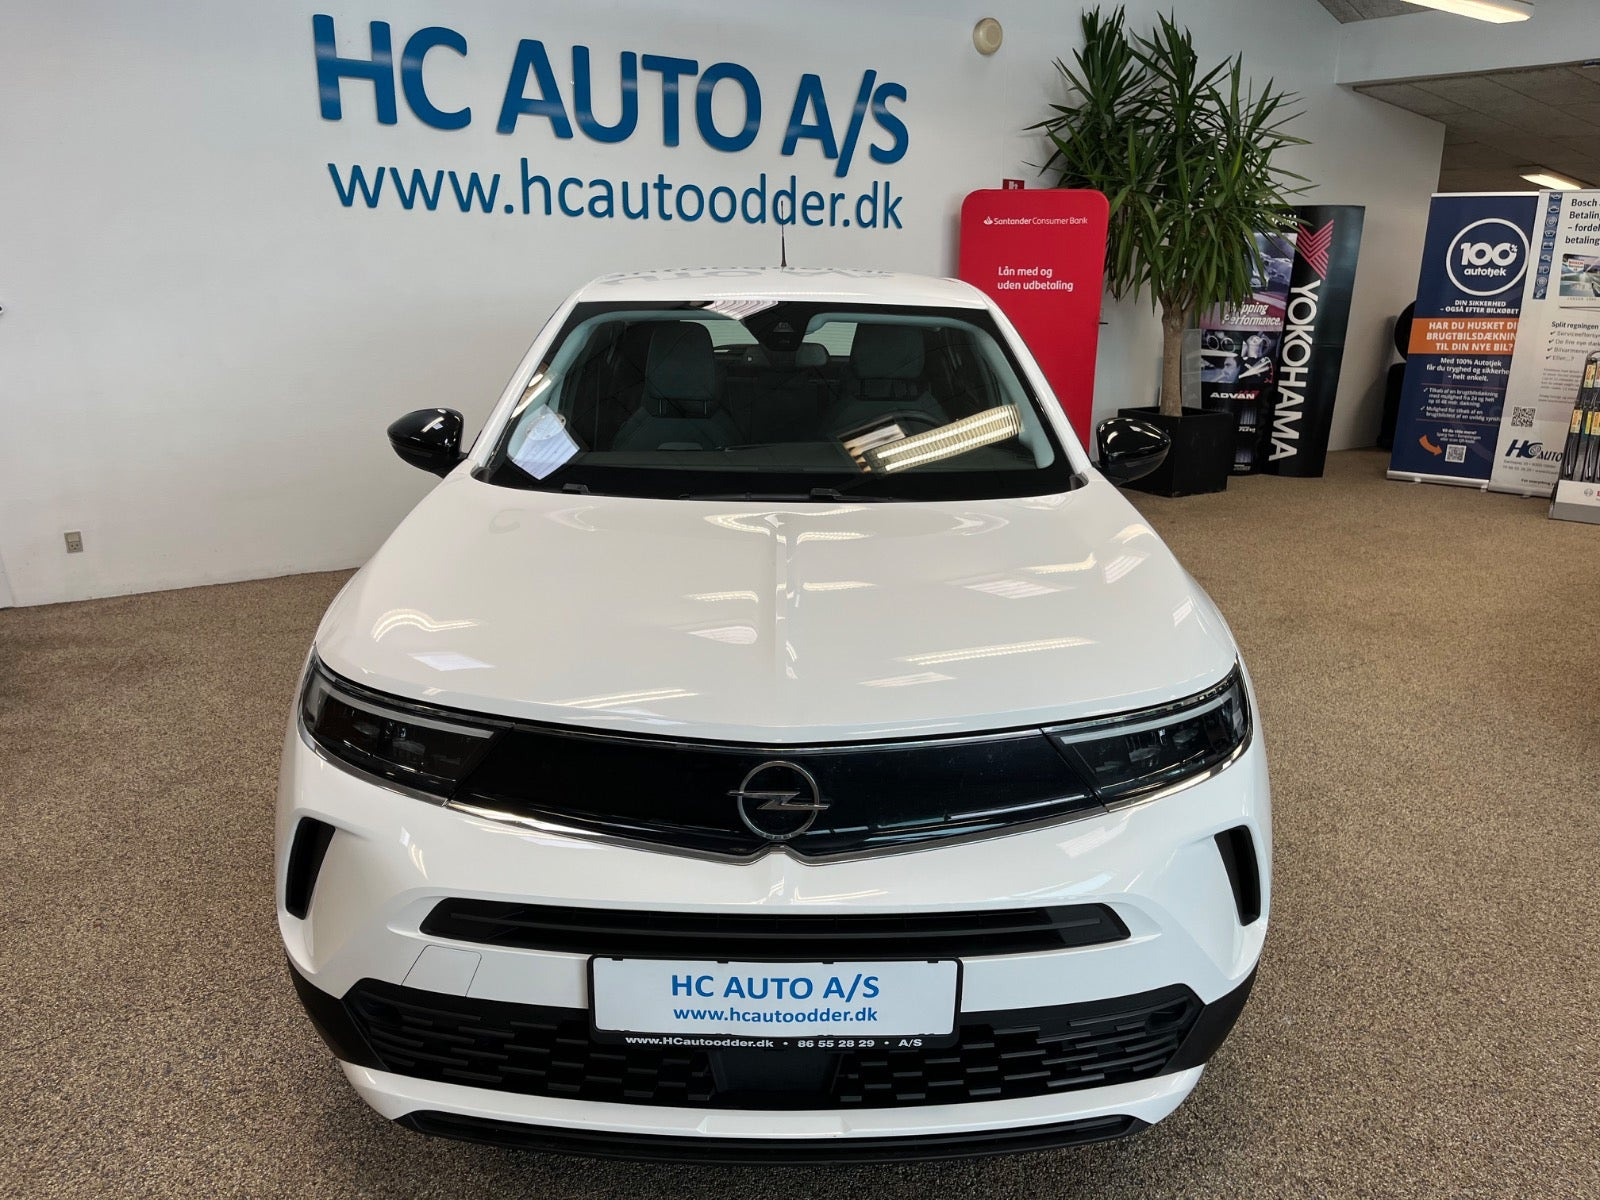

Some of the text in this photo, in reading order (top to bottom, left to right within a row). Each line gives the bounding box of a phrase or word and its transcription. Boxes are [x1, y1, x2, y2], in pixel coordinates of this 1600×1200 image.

[313, 14, 909, 177] HC AUTO A/S
[328, 158, 902, 229] www.hcautoodder.dk
[1571, 198, 1598, 207] Bosch
[993, 216, 1088, 225] Santander Consumer Bank
[1569, 210, 1600, 221] Betalin
[998, 265, 1053, 279] Lån med og
[1464, 267, 1507, 278] autotjek
[997, 280, 1074, 292] uden udbetaling
[1446, 305, 1464, 313] OGSÅ
[1486, 307, 1519, 315] BILKØBET
[1429, 321, 1517, 330] HAR DU HUSKET DI
[1551, 320, 1599, 330] Split regningen
[1426, 332, 1517, 341] BRUGTBILSDÆKNIN
[1436, 342, 1513, 352] TIL DIN NYE BIL?
[1474, 359, 1502, 367] Autotjek
[1268, 279, 1321, 461] YOKOHAMA
[1446, 365, 1472, 374] tryghed
[1466, 374, 1489, 382] enkelt.
[1210, 391, 1255, 399] ADVAN
[1536, 451, 1563, 462] AUTO
[672, 974, 880, 1003] HC AUTO A/S
[673, 1007, 878, 1023] www.hcautoodder.dk
[625, 1036, 923, 1048] www.HCautoodder.dk 86 55 28 29 A/S
